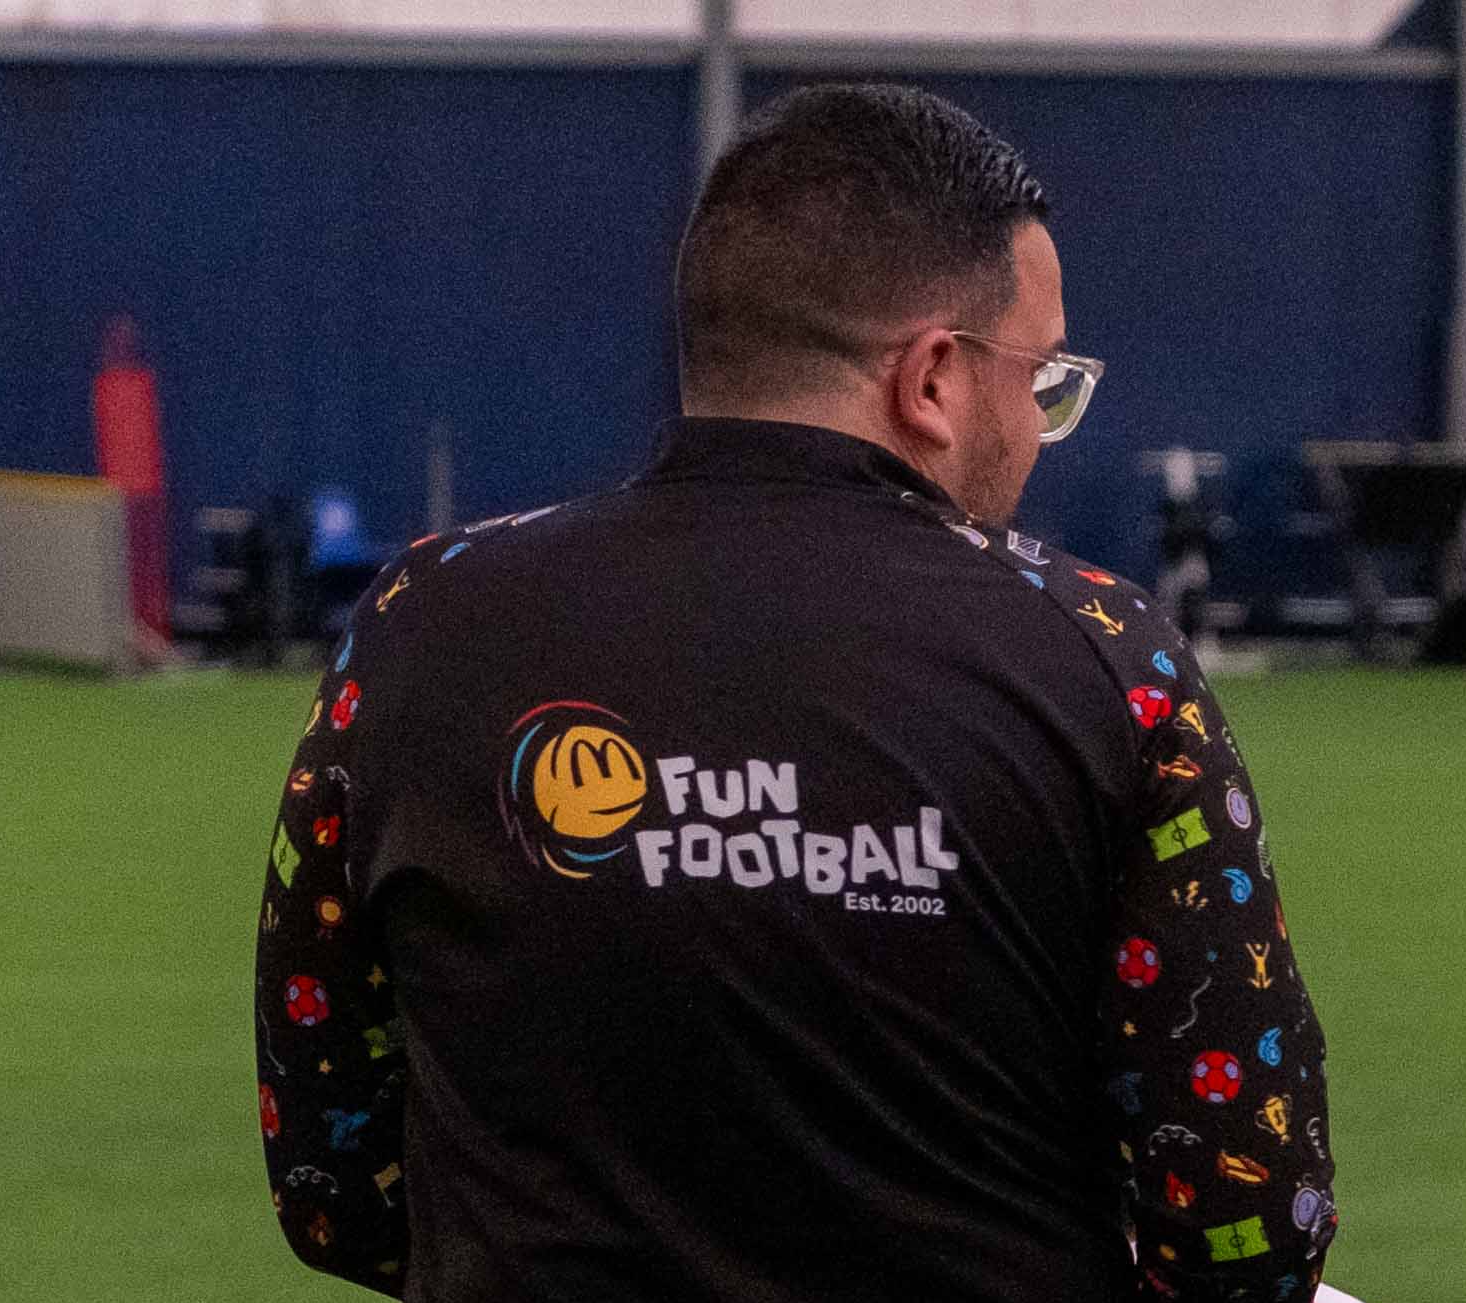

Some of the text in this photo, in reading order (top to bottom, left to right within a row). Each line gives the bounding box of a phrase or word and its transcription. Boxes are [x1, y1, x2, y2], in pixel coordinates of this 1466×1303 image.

[657, 756, 799, 818] FUN
[635, 806, 959, 894] FOOTBALL
[845, 892, 946, 916] Est. 2002
